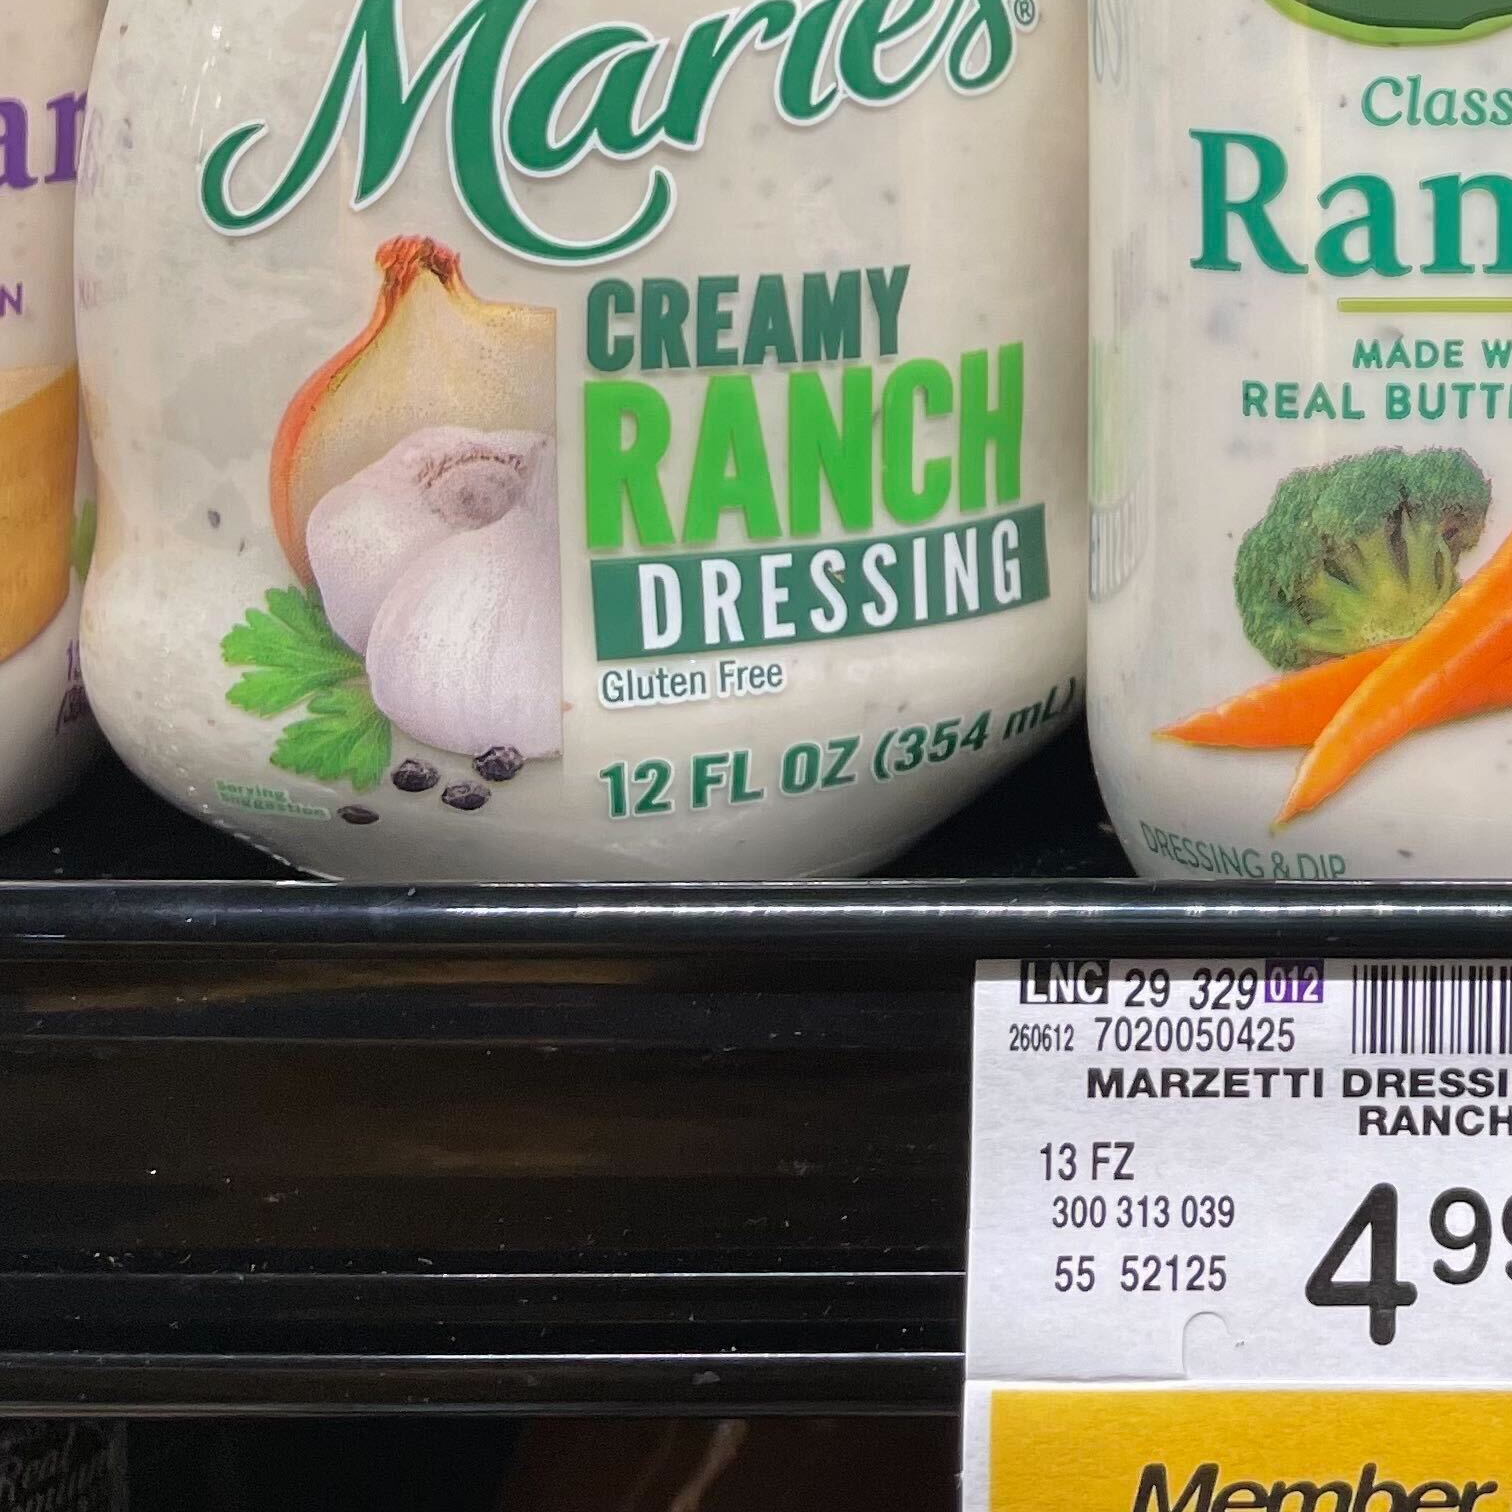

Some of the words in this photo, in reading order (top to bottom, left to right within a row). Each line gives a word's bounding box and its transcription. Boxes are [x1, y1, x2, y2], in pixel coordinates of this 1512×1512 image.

[587, 265, 910, 372] CREAMY
[1352, 339, 1464, 369] MADE
[1241, 380, 1366, 419] REAL
[584, 341, 1023, 549] RANCH
[639, 519, 1022, 651] DRESSING
[601, 662, 706, 704] Gluten
[719, 660, 783, 693] Free
[600, 759, 672, 817] 12
[691, 751, 763, 809] FL
[781, 736, 860, 794] OZ
[873, 709, 992, 780] (354
[1139, 819, 1264, 878] DRESSING
[1271, 851, 1290, 879] &
[1297, 853, 1345, 879] DIP
[1026, 962, 1104, 1003] LNC
[1125, 969, 1170, 1007] 29
[1189, 968, 1258, 1010] 329
[1270, 967, 1321, 1002] 012
[1010, 1023, 1074, 1051] 260612
[1094, 1016, 1295, 1052] 7020050425
[1087, 1068, 1324, 1098] MARZETTI
[1040, 1142, 1076, 1180] 13
[1092, 1142, 1135, 1180] FZ
[1052, 1196, 1106, 1227] 300
[1117, 1196, 1169, 1227] 313
[1181, 1196, 1234, 1227] 039
[1055, 1255, 1095, 1292] 55
[1120, 1255, 1226, 1292] 52125
